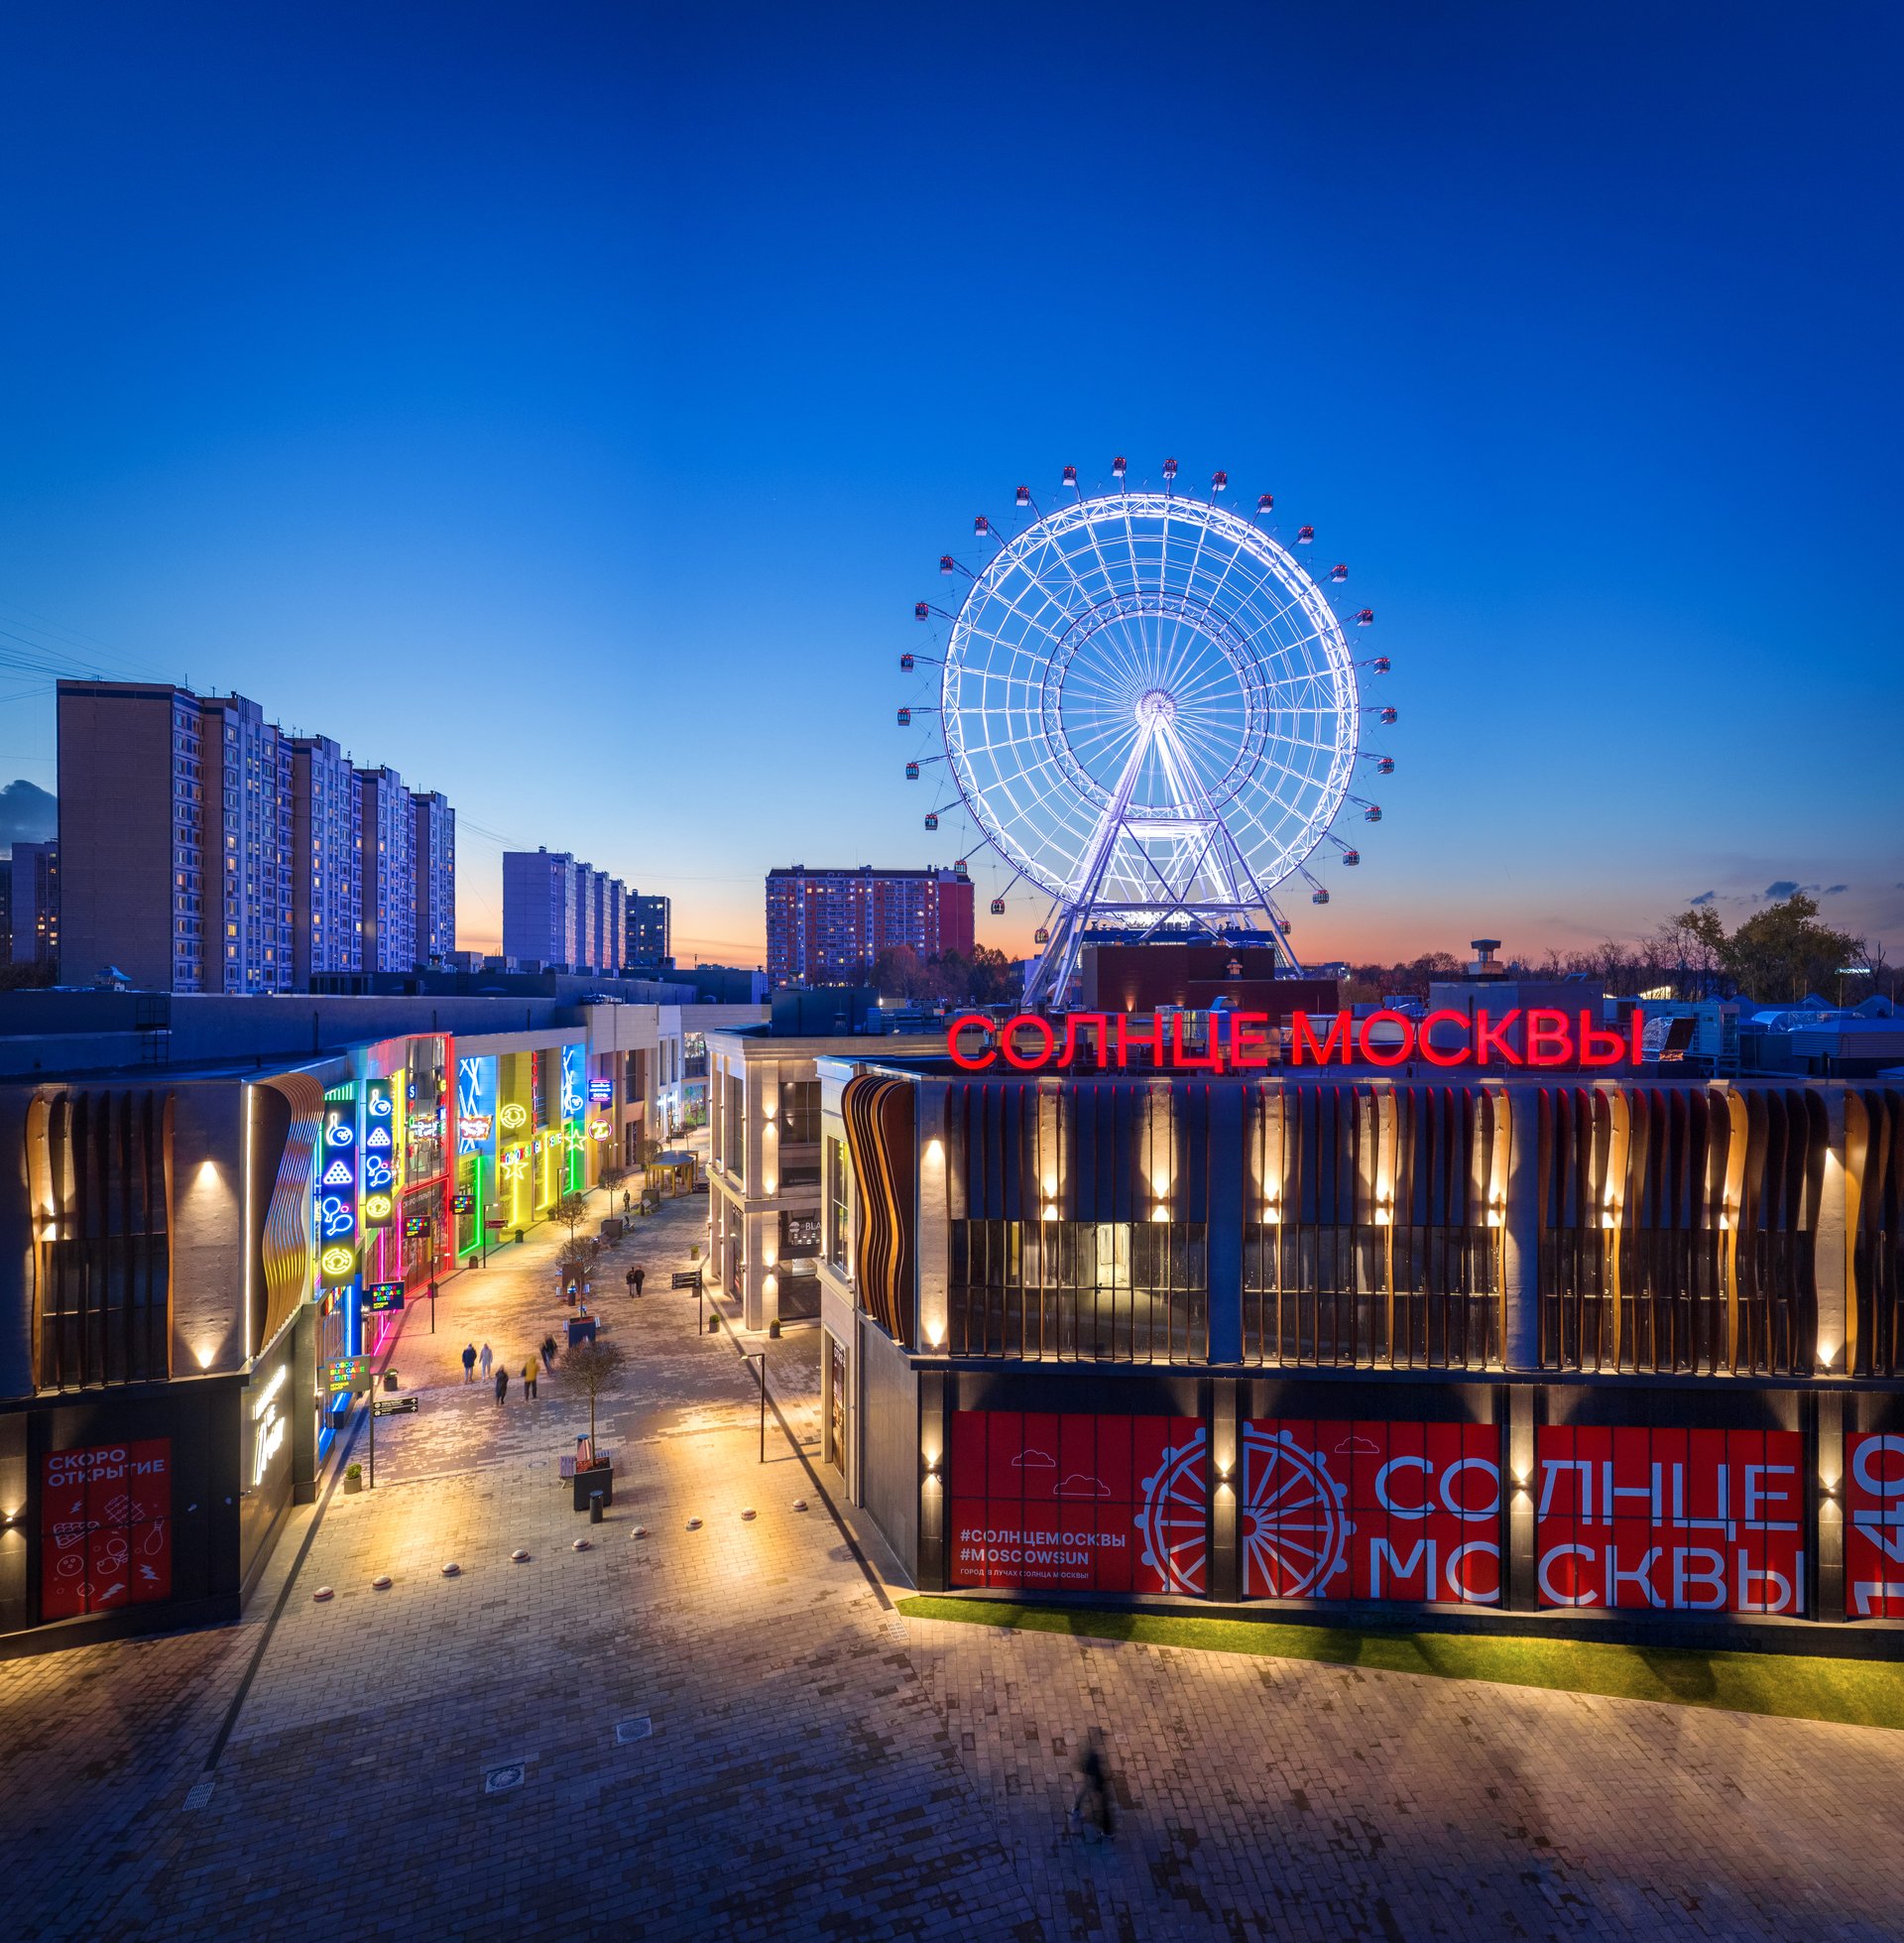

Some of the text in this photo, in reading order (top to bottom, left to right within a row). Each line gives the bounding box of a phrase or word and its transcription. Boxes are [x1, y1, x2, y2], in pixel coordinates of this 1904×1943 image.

[947, 1008, 1643, 1073] СОЛНЦЕ МОСКВЫ
[329, 1374, 357, 1383] CENTER
[49, 1449, 126, 1470] СКОРО
[49, 1459, 165, 1487] ОТКРЫТИЕ
[1374, 1455, 1798, 1542] СОЛНЦЕ
[960, 1528, 1126, 1547] #СОЛНЦЕМОСКВЫ
[960, 1548, 1089, 1565] #MOSCOWSUN
[1369, 1537, 1805, 1614] МОСКВЫ
